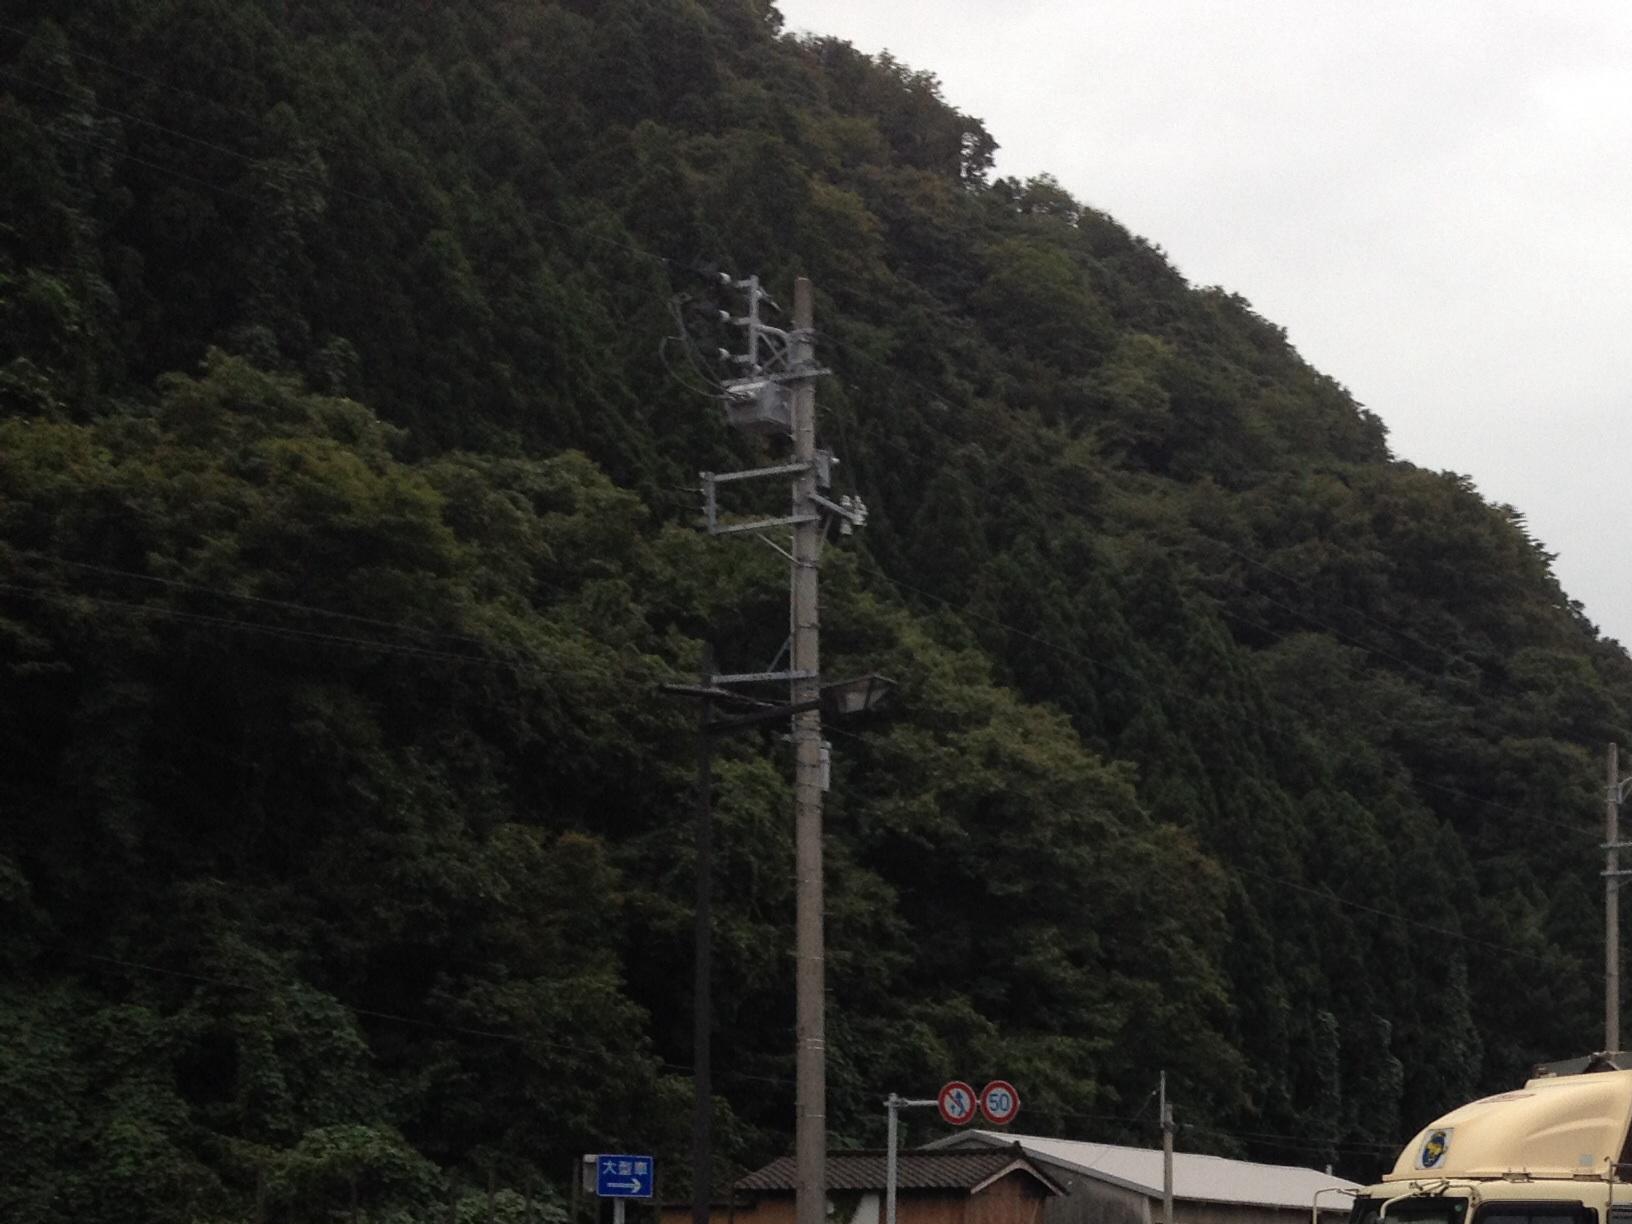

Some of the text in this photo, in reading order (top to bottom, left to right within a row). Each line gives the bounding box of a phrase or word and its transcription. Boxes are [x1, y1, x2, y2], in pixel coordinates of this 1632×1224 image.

[988, 1093, 1010, 1112] 50
[602, 1160, 649, 1176] 大型車
